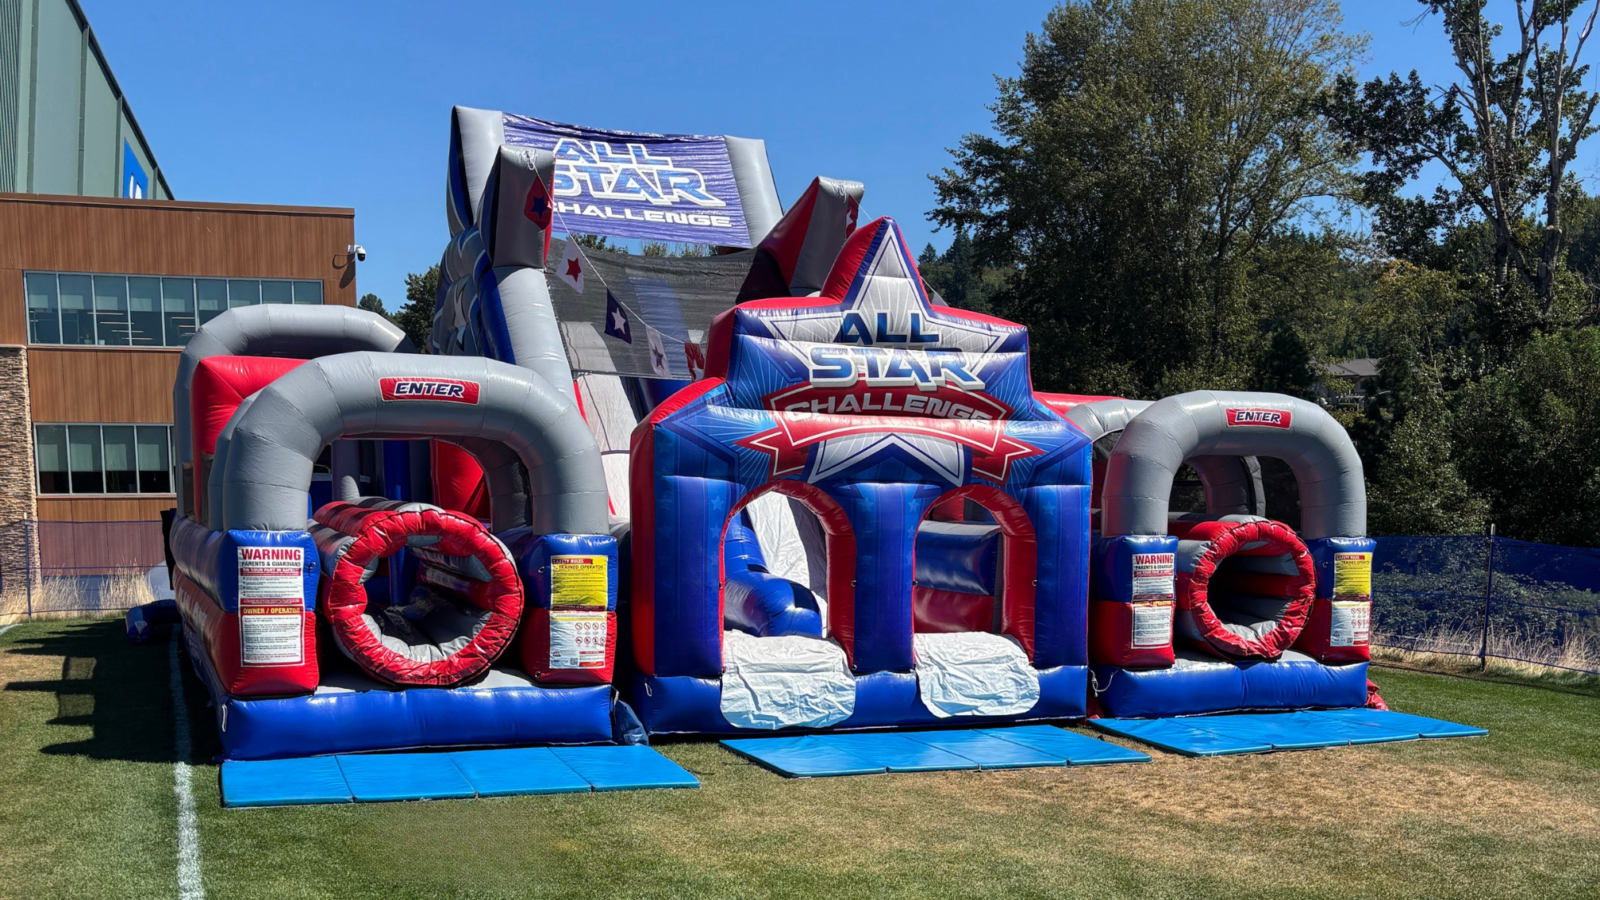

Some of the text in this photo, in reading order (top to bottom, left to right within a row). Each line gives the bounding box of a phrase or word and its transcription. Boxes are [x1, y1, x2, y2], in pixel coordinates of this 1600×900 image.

[553, 137, 673, 167] ALL
[553, 202, 732, 227] HALLENGE
[832, 310, 941, 346] ALL
[810, 347, 985, 391] STAR
[394, 381, 464, 398] ENTER
[784, 391, 994, 424] CHALLENGE
[1235, 411, 1281, 424] ENTER
[241, 548, 301, 560] WARNING
[1135, 555, 1173, 565] WARNING
